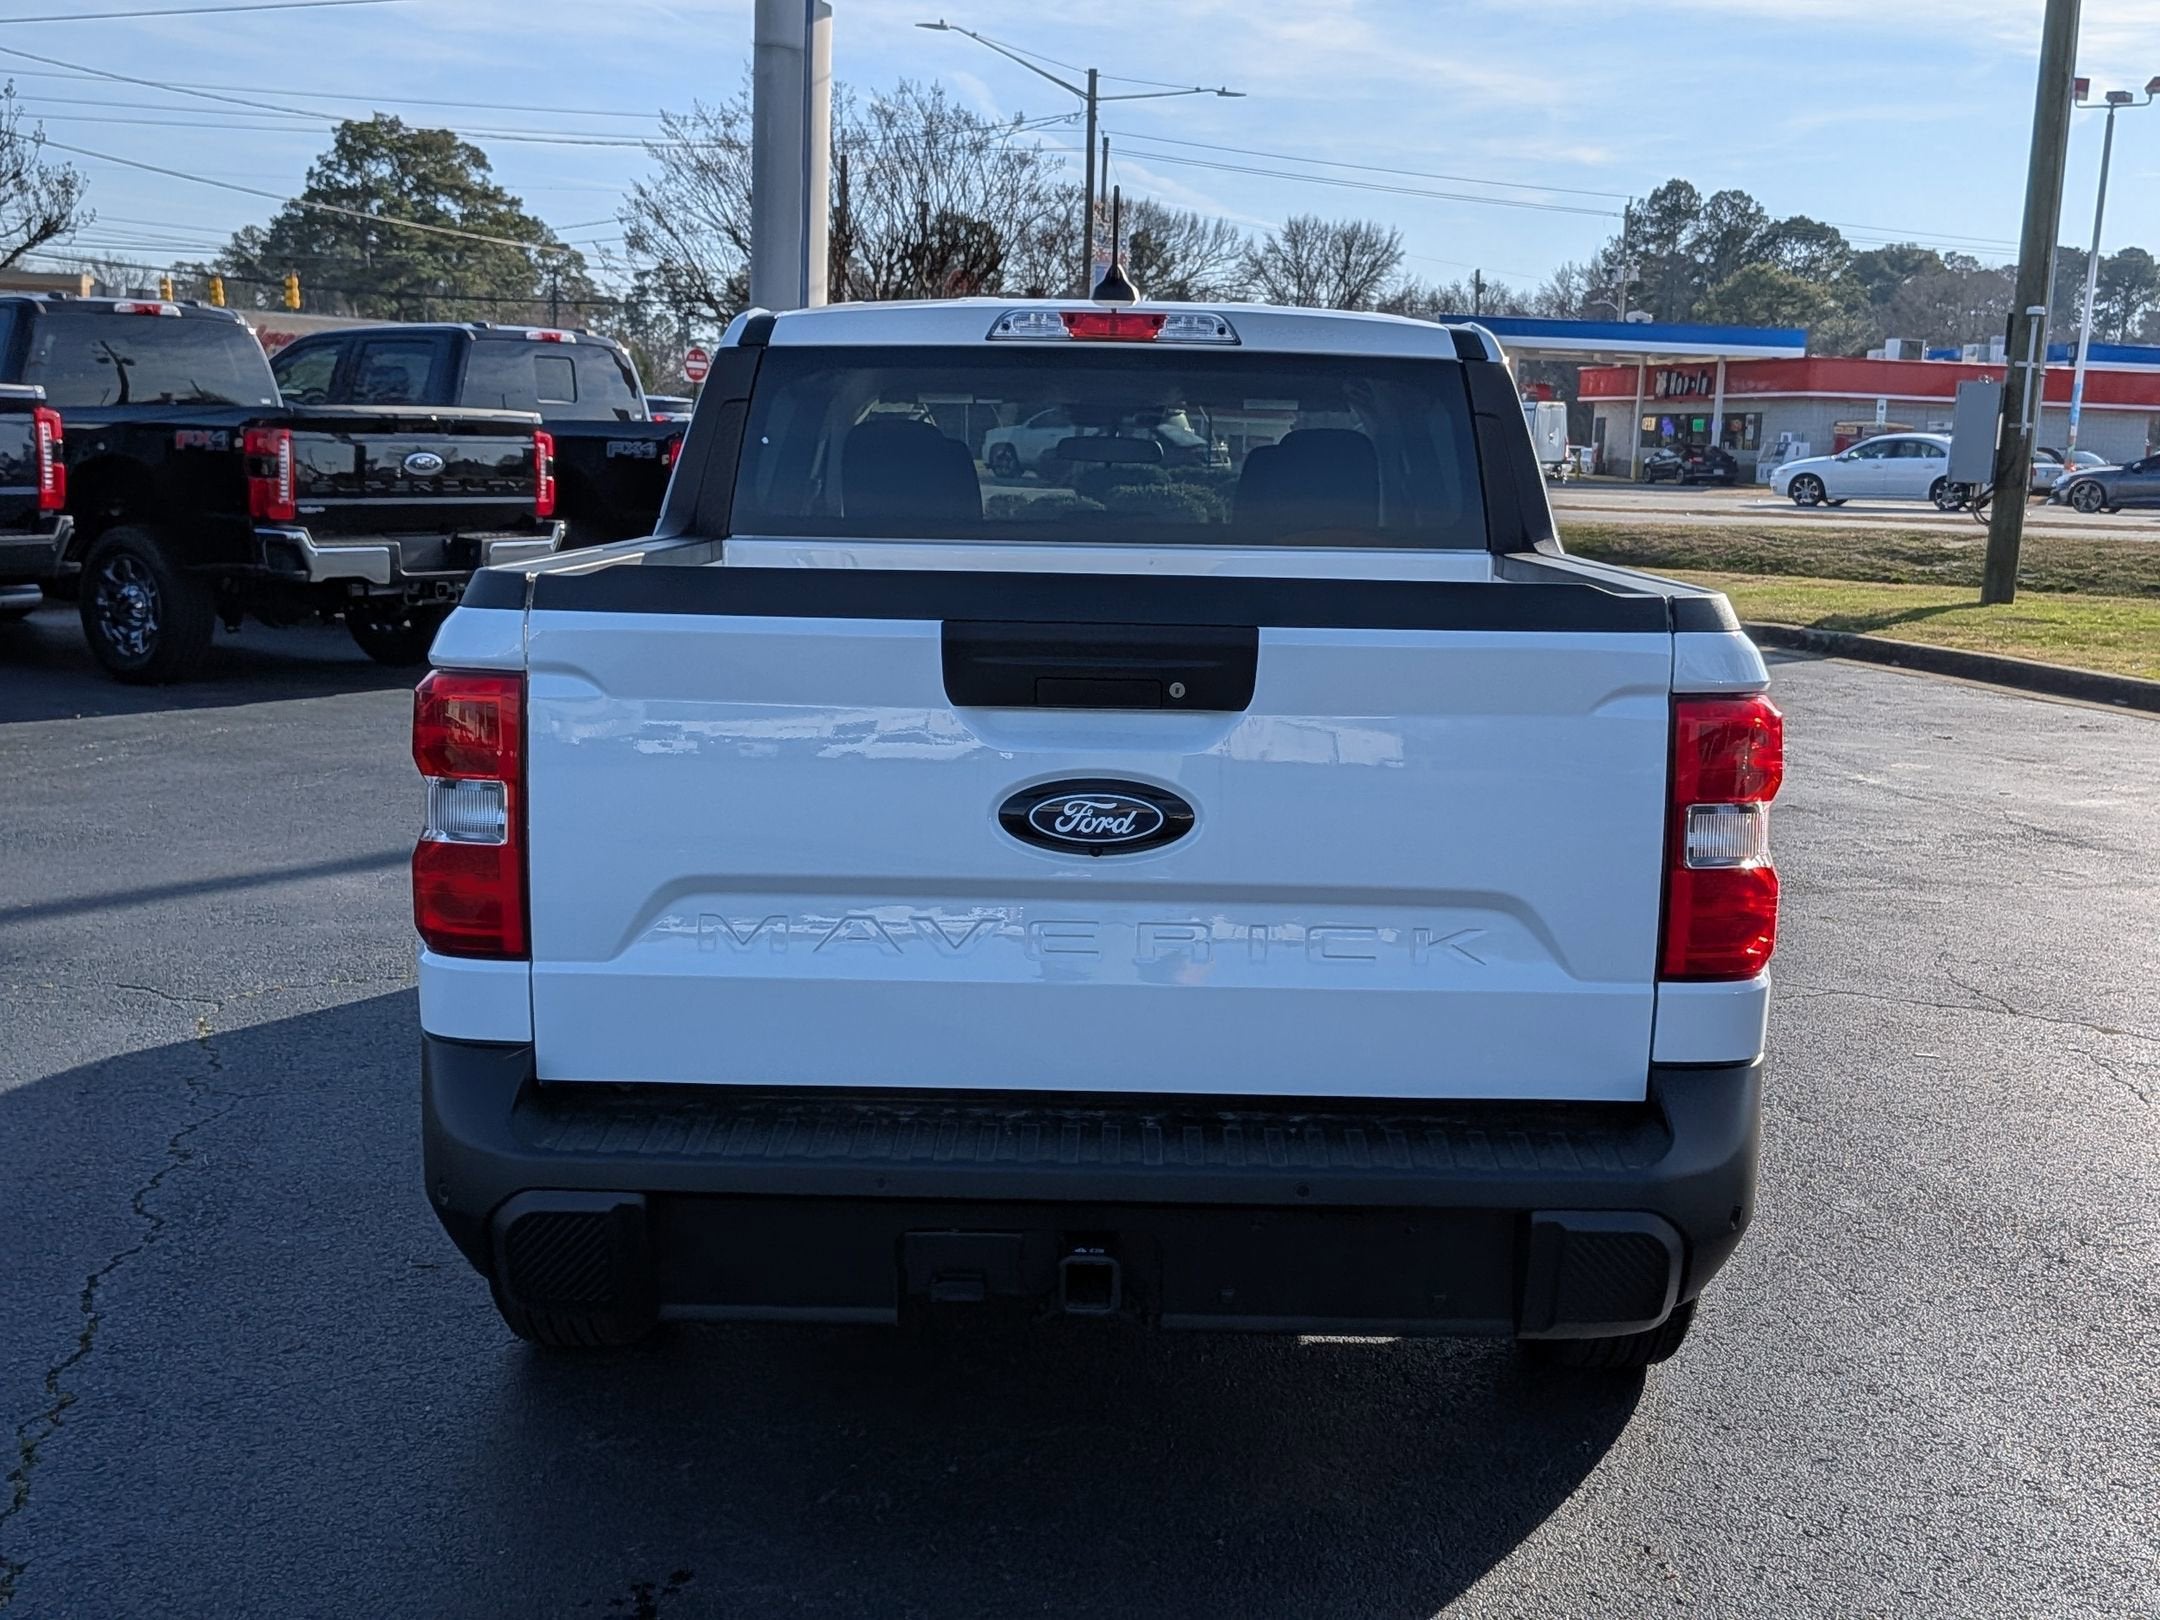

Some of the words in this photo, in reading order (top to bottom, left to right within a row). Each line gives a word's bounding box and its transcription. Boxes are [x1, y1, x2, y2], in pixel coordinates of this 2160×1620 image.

[606, 441, 657, 457] FX4
[1054, 800, 1137, 834] Ford
[698, 913, 1487, 967] MAVERICK
